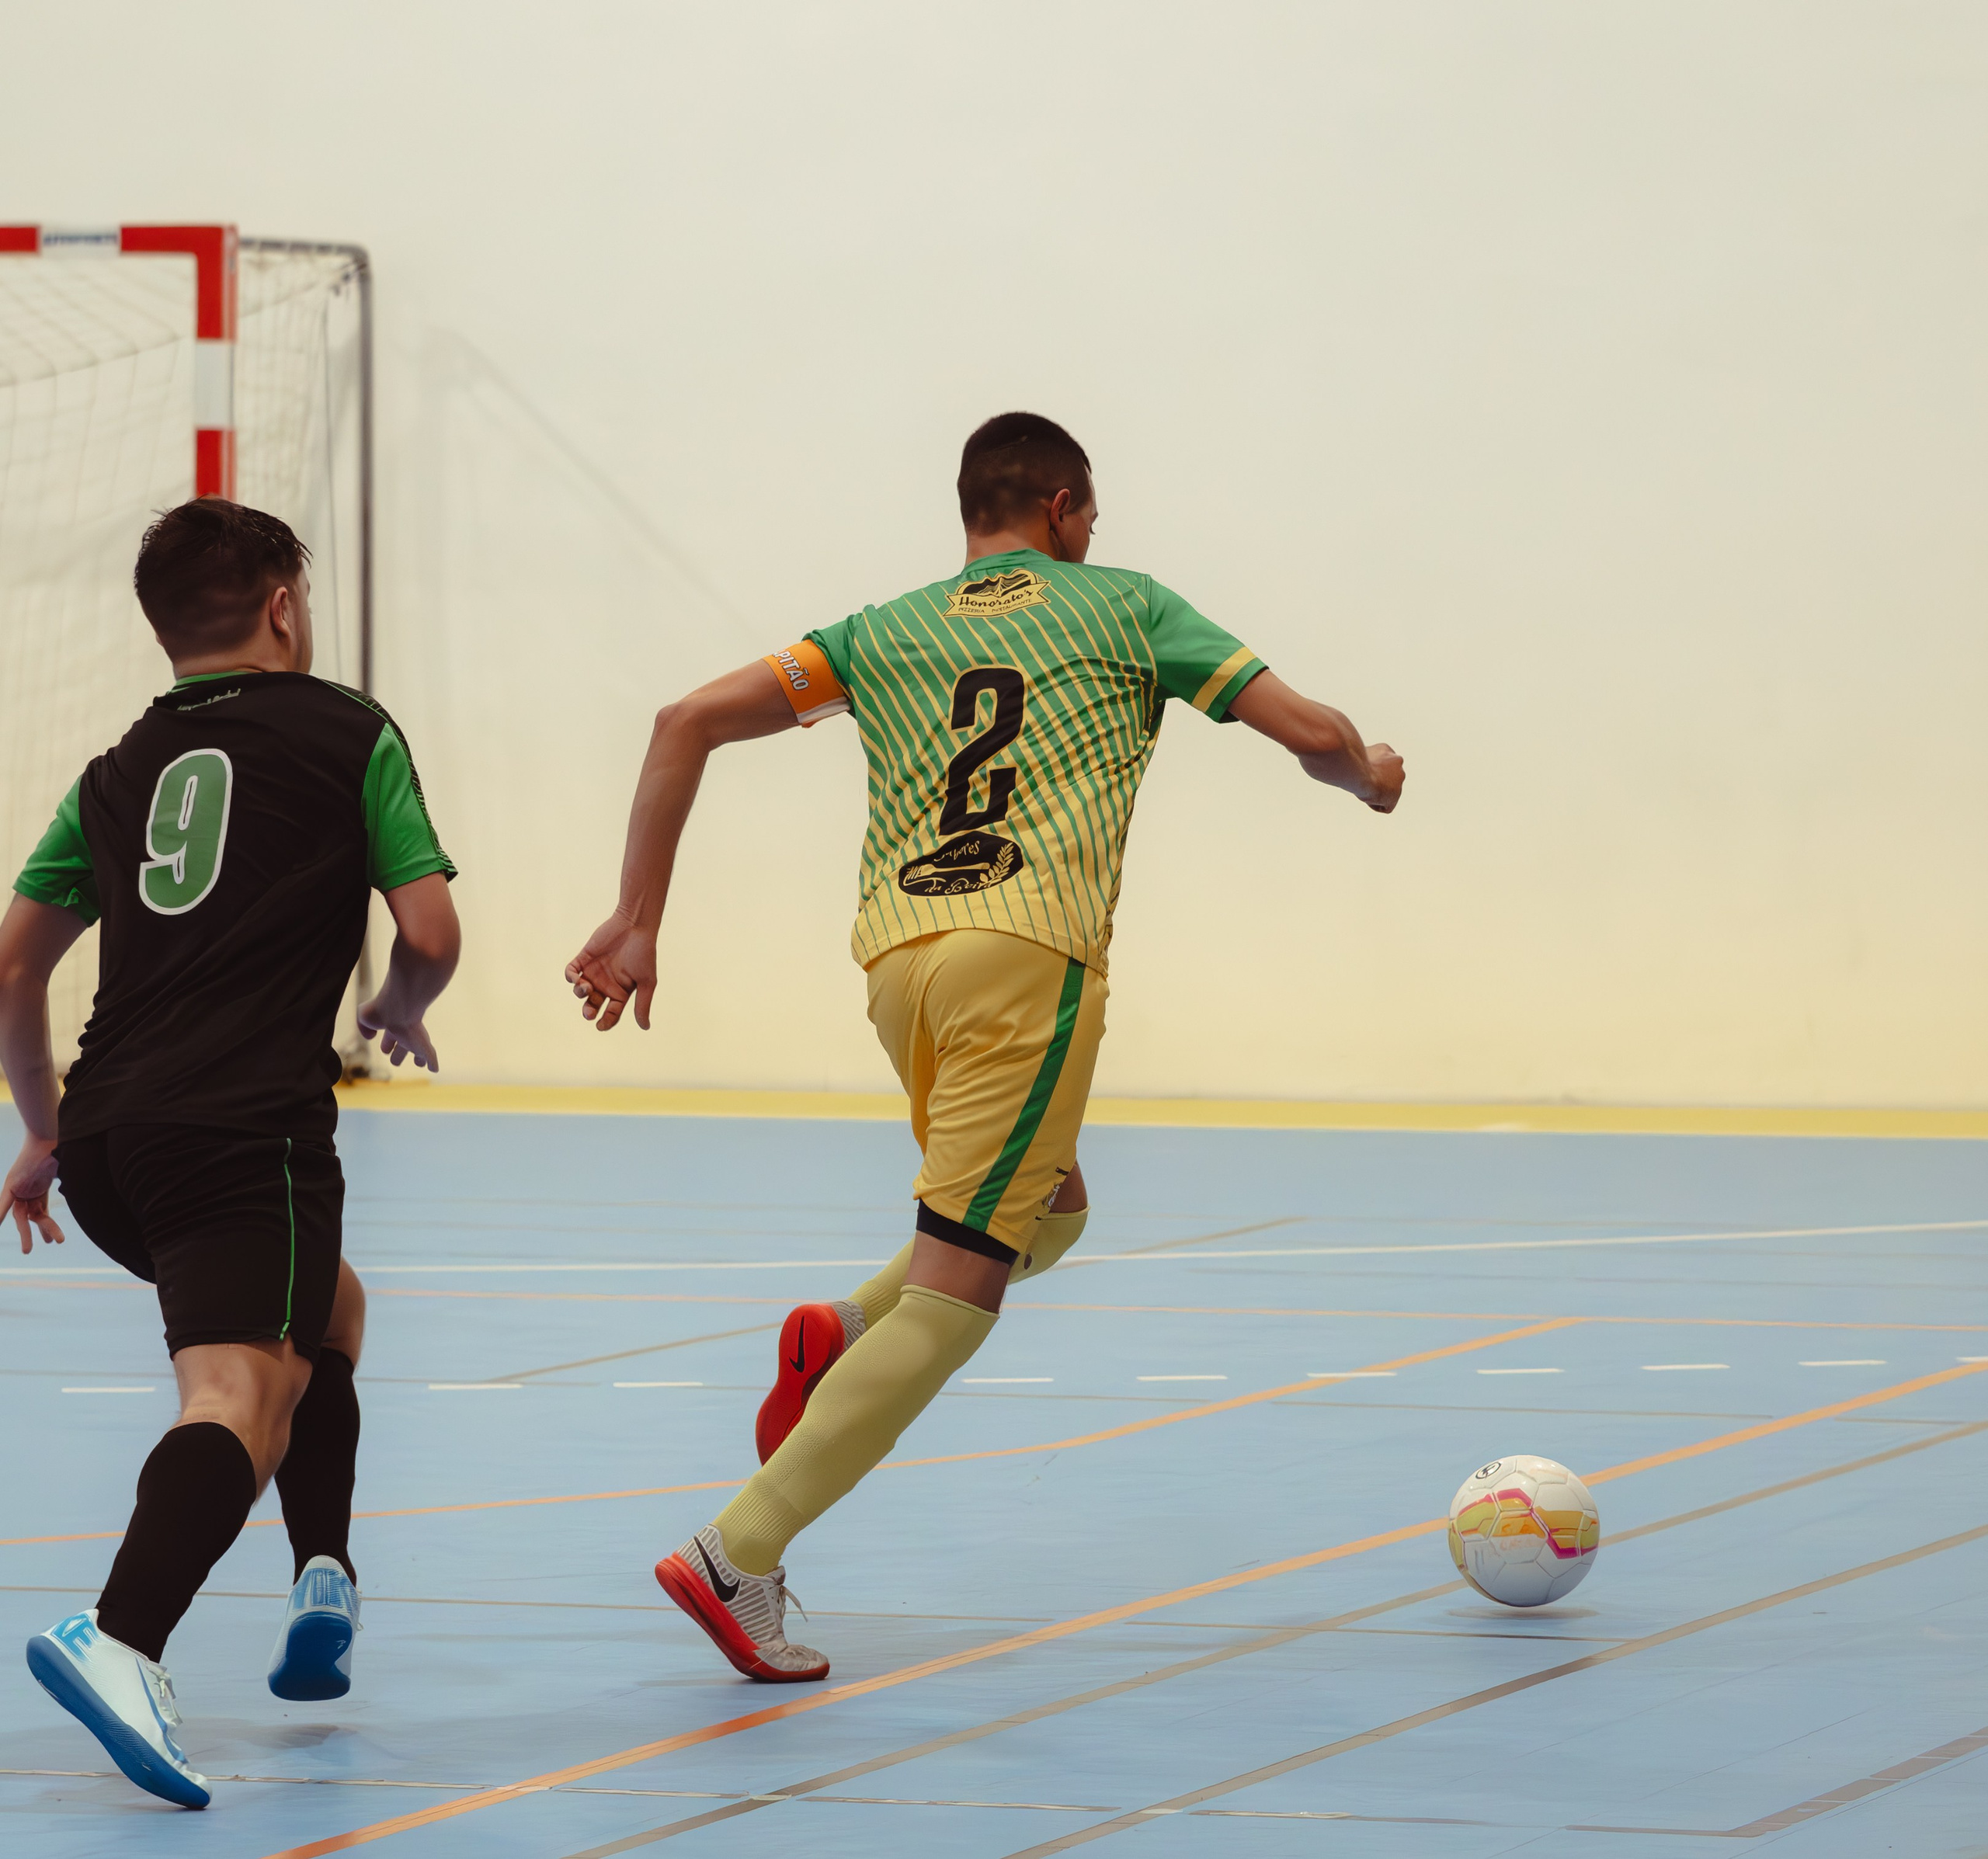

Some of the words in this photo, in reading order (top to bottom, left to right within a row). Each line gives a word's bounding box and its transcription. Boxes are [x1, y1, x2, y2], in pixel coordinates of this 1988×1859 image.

[958, 589, 1034, 608] Honorato's
[773, 650, 810, 691] PITÃO
[939, 667, 1025, 836] 2
[139, 748, 233, 916] 9
